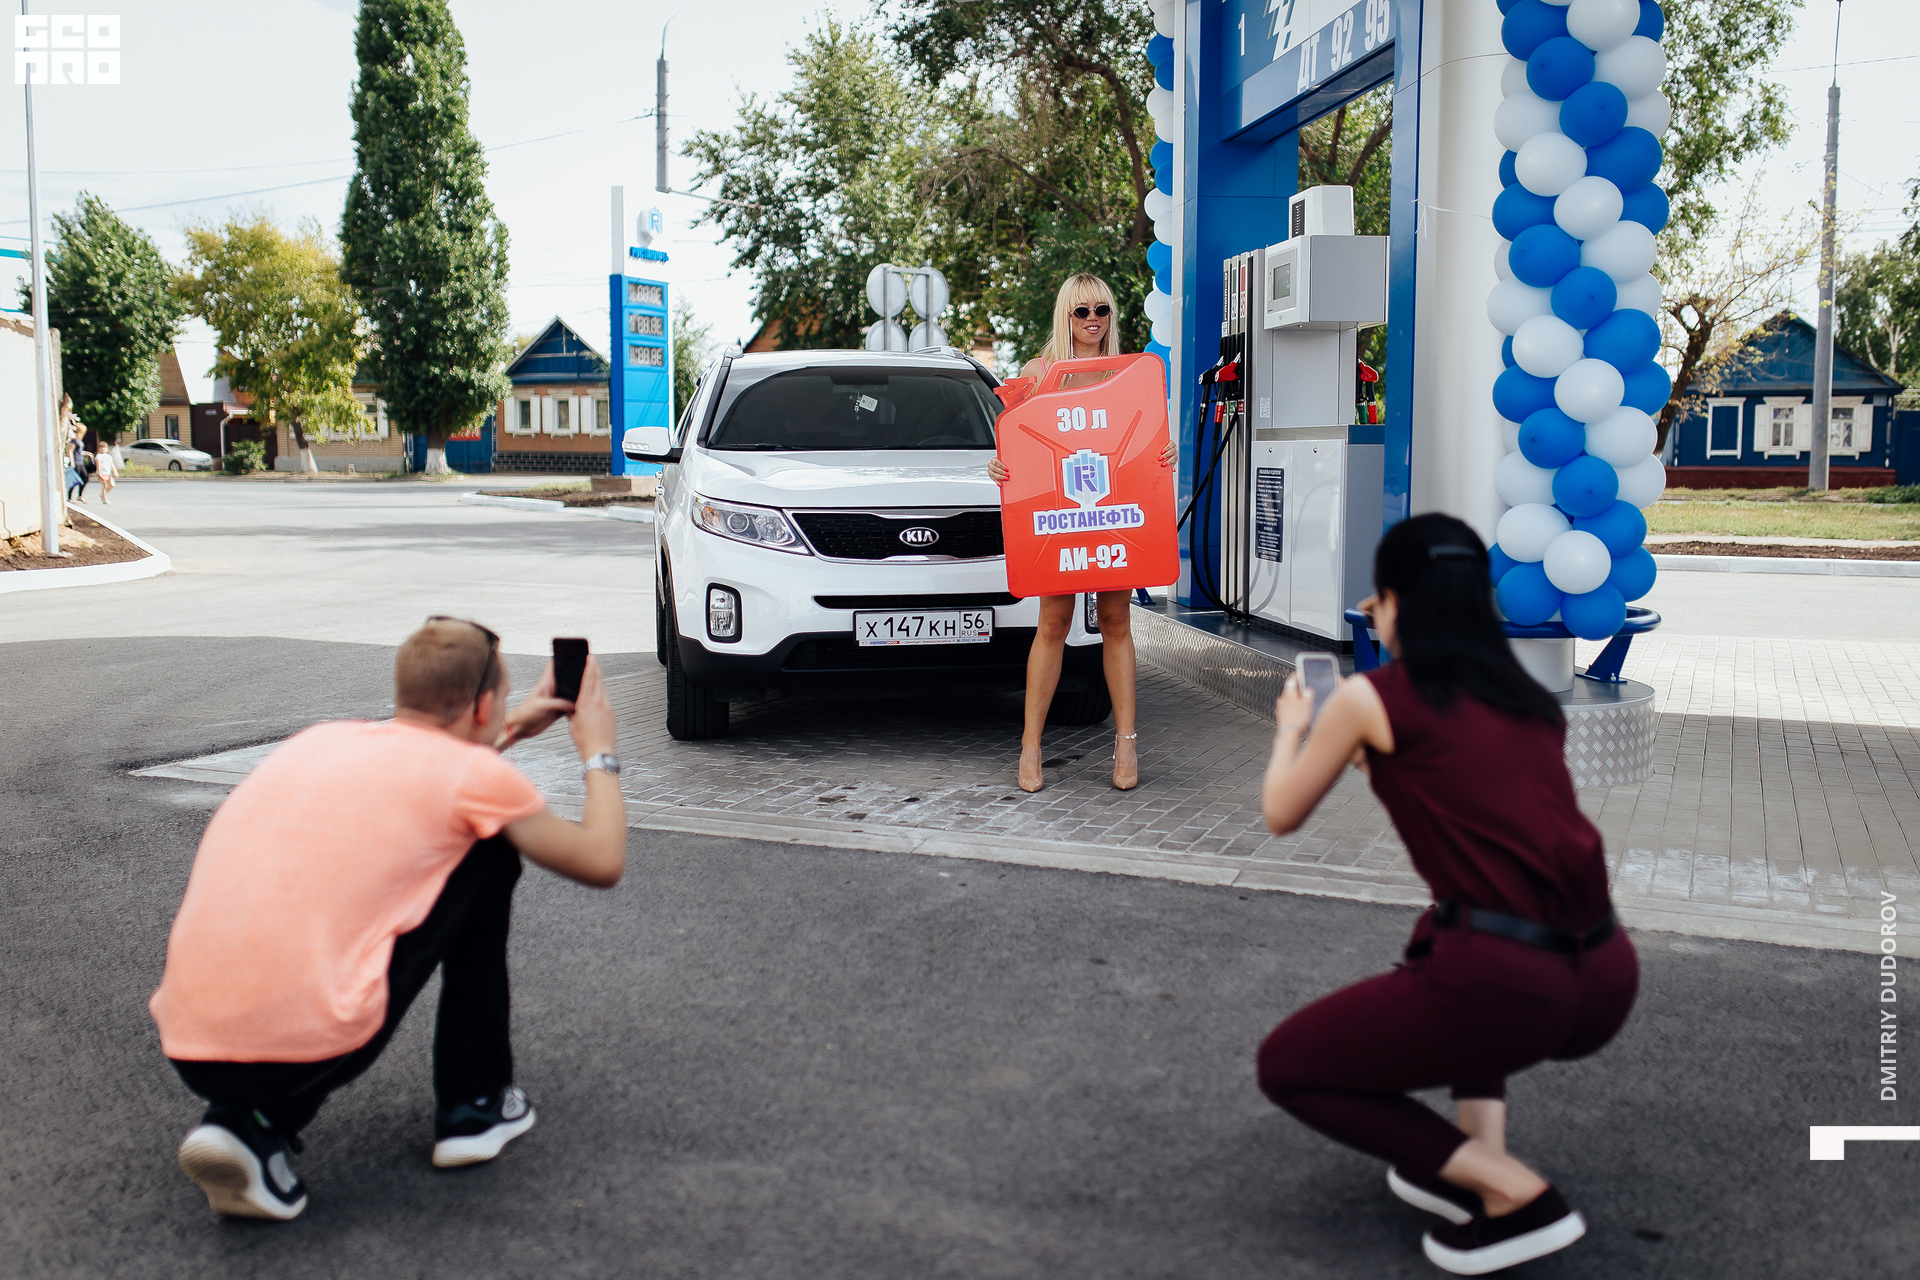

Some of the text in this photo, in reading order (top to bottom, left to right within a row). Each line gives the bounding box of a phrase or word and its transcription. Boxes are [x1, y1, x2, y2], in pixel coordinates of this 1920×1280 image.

[1238, 13, 1245, 56] 1
[1297, 0, 1391, 95] ДТ 92 95
[1056, 406, 1107, 432] 30 л
[1037, 507, 1141, 531] РОСТАНЕФТЬ
[906, 530, 934, 542] KIA
[1059, 543, 1128, 572] АИ-92
[961, 629, 977, 637] RUS
[963, 613, 985, 629] 56
